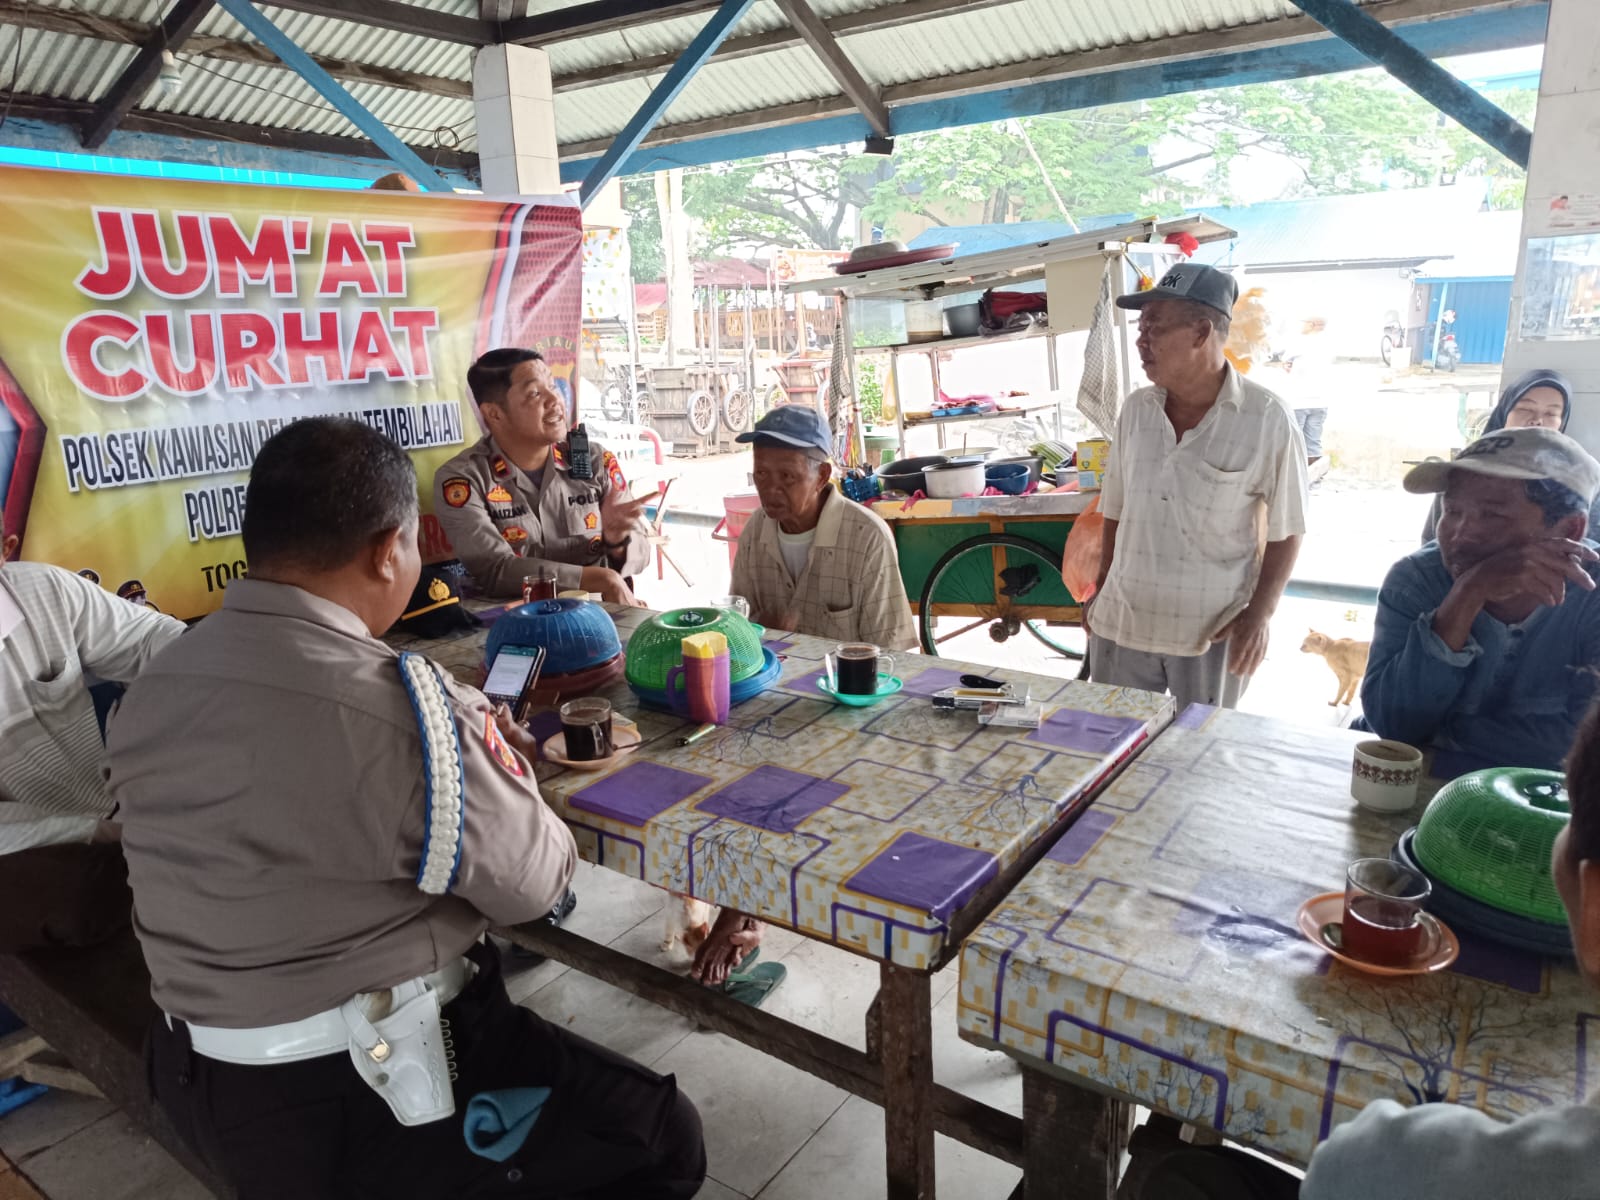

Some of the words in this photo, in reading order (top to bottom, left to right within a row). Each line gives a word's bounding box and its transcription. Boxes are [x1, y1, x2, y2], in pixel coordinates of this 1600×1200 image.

[74, 206, 415, 300] JUM'AT
[61, 307, 439, 401] CURHAT
[535, 335, 573, 353] RIAU
[61, 429, 155, 489] POLSEK
[153, 420, 257, 477] KAWASAN
[363, 402, 463, 447] TEMBILAHAN
[184, 483, 247, 539] POLRE
[200, 559, 248, 593] TOG
